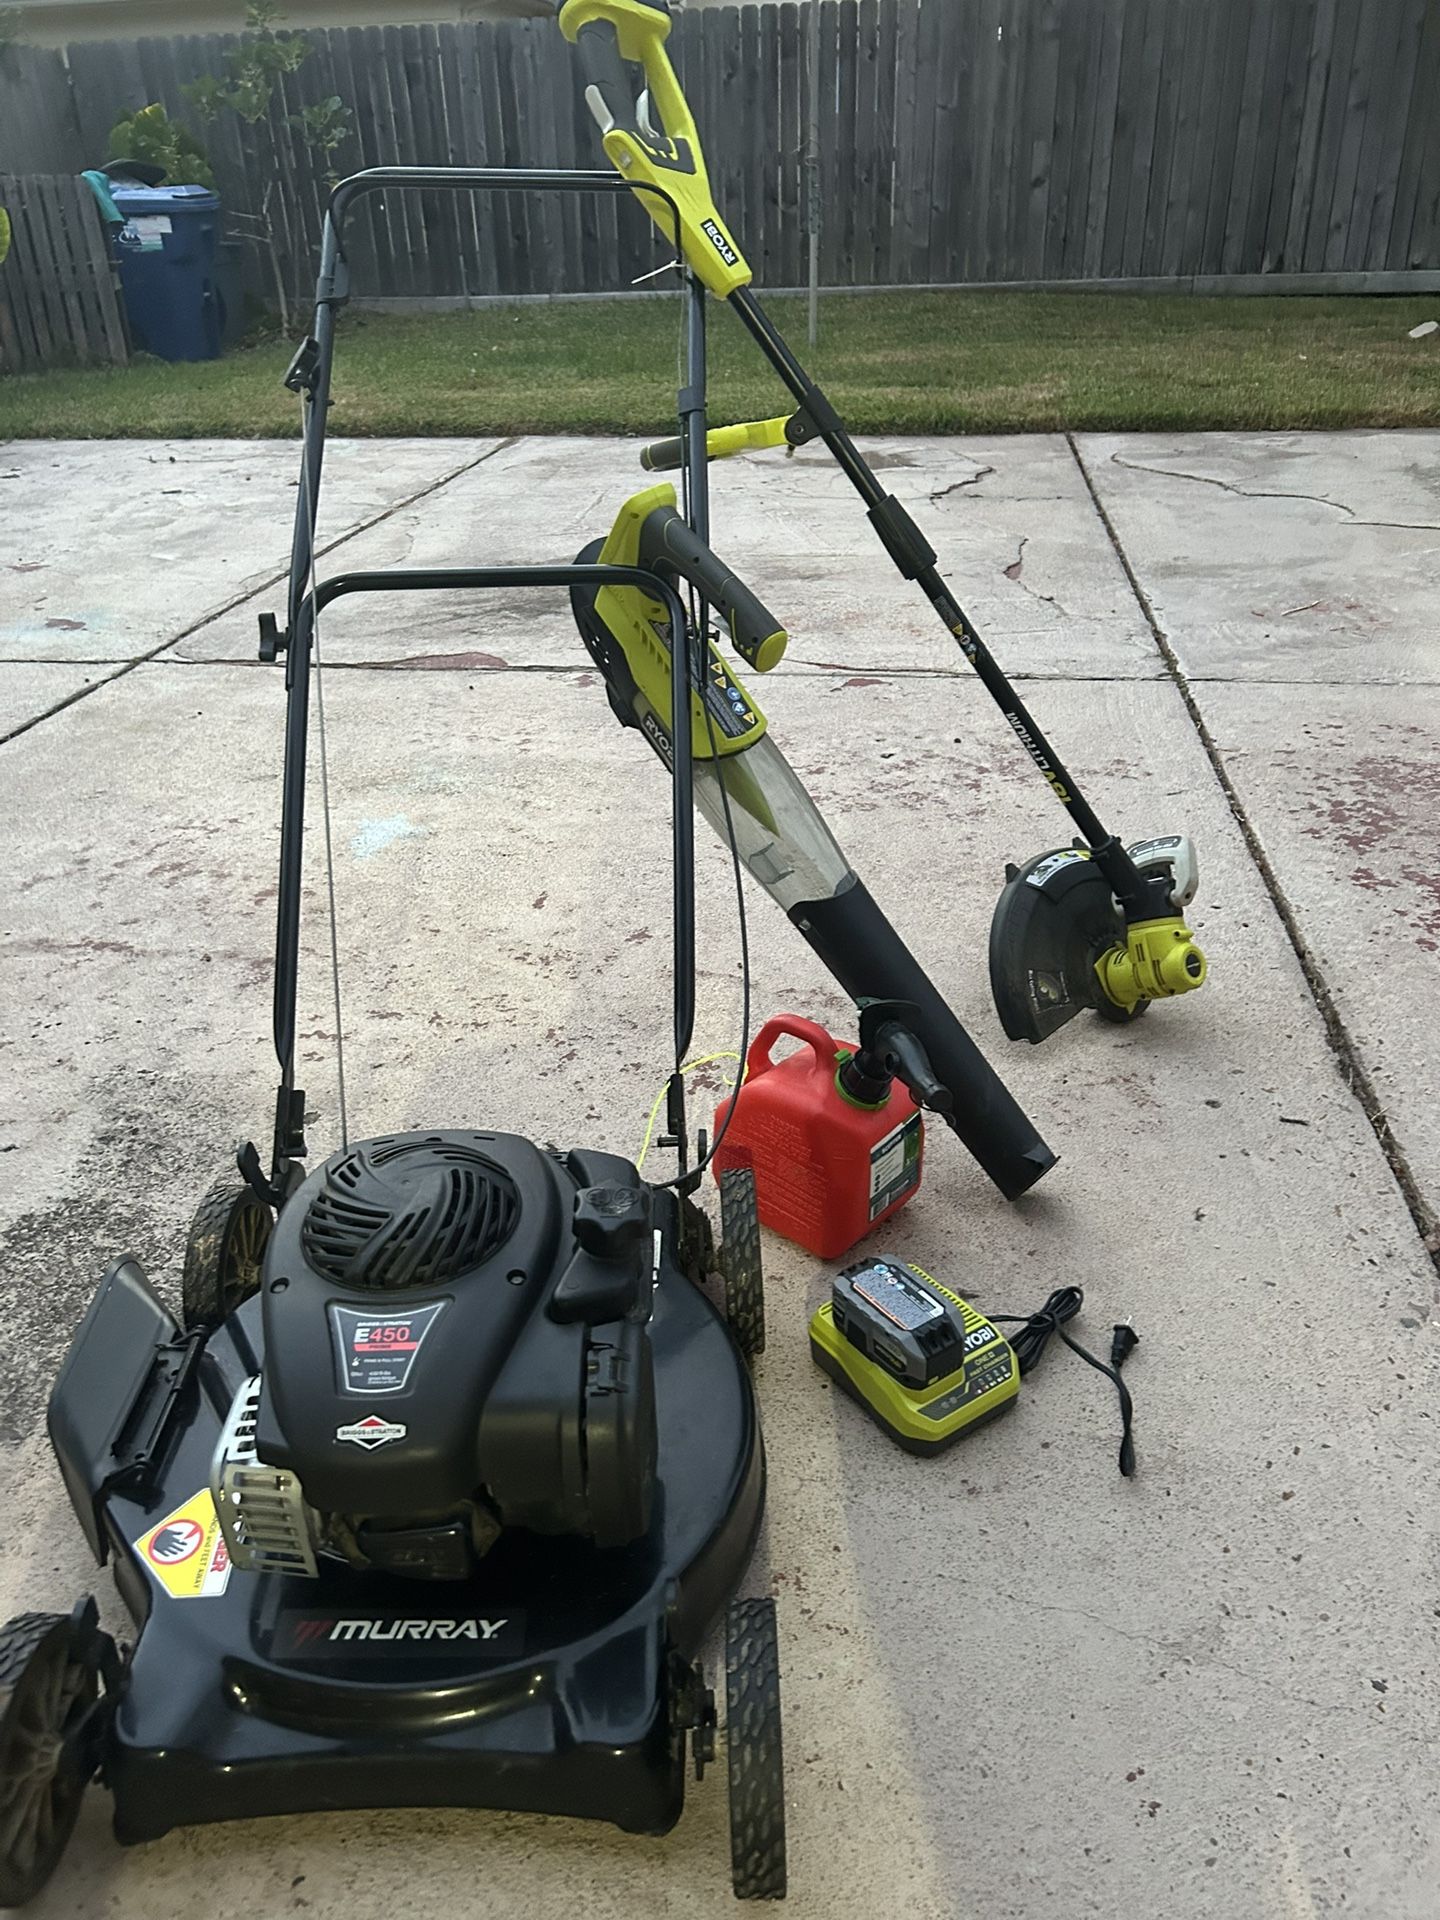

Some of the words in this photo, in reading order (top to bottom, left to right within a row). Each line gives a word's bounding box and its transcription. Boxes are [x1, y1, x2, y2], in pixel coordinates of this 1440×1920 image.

[703, 221, 736, 264] RYOBI
[1006, 712, 1051, 770] LITHIUM
[1041, 770, 1073, 806] 18V
[353, 1326, 411, 1343] E450
[964, 1326, 995, 1352] YOBI
[328, 1619, 509, 1641] MURRAY
